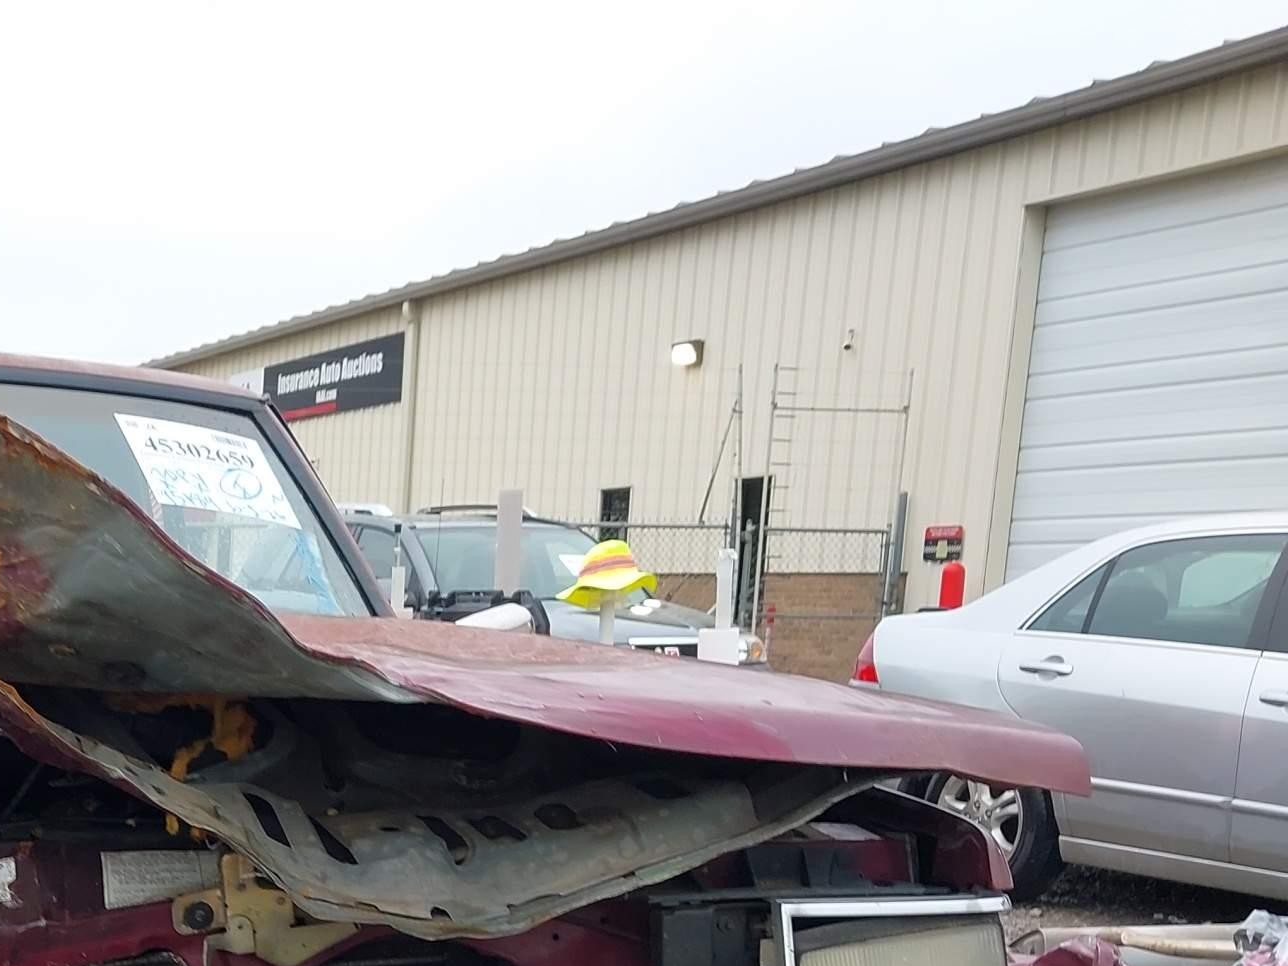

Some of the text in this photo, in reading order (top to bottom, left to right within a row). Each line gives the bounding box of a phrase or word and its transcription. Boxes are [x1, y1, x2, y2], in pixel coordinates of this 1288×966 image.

[277, 351, 384, 396] Insurance Auto Auctions
[144, 435, 255, 469] 45302659
